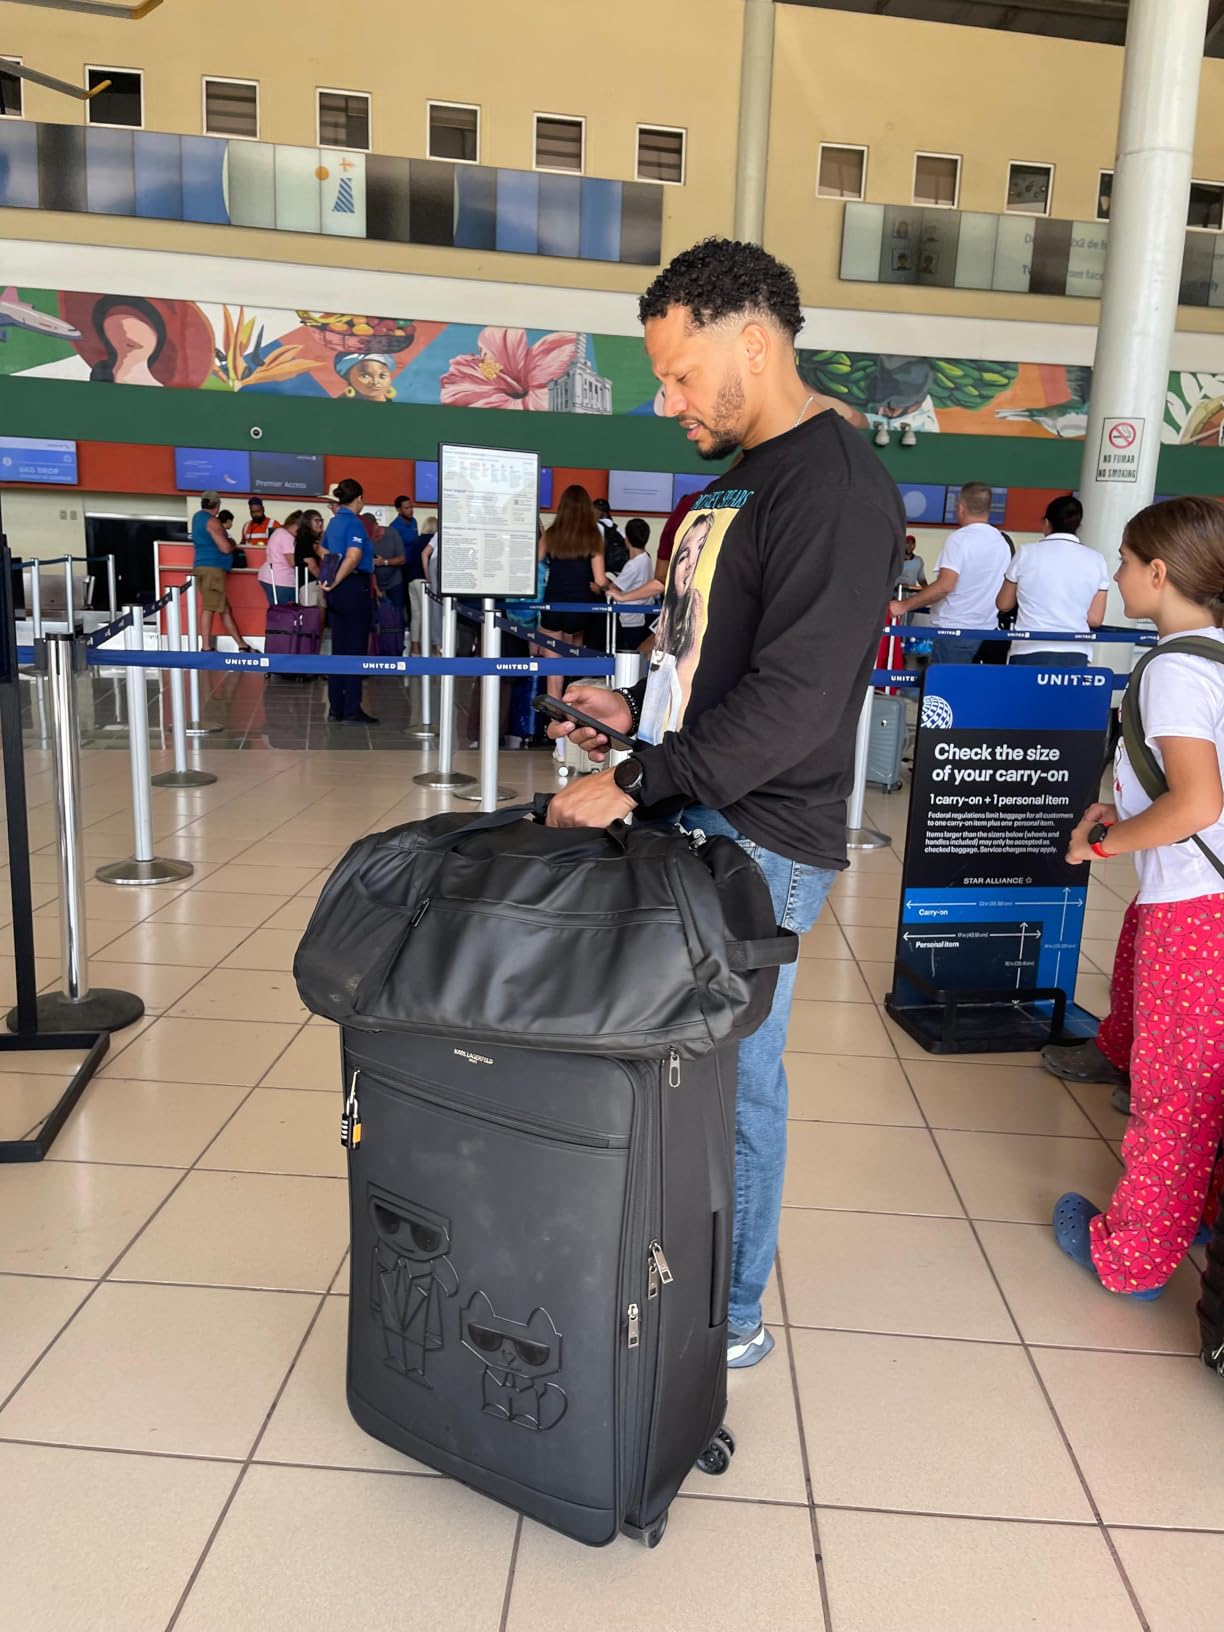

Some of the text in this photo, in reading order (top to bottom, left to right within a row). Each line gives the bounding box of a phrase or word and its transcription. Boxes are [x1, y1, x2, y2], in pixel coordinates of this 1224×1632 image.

[1103, 454, 1135, 463] NO FUMAR
[1098, 469, 1136, 478] NO SMOKING
[225, 658, 259, 666] UNITED
[362, 662, 396, 670] UNITED
[496, 663, 529, 671] UNITED
[1037, 674, 1106, 686] UNITED
[934, 743, 1060, 761] Check the size
[932, 765, 1069, 785] of your carry-on
[930, 793, 935, 804] 1
[936, 796, 983, 807] carry-on
[993, 794, 998, 805] 1
[999, 795, 1045, 807] personal
[1046, 795, 1069, 806] item
[952, 812, 986, 820] regulations
[1000, 812, 1026, 820] baggage
[988, 820, 1000, 828] plus
[1014, 820, 1040, 828] personal
[944, 831, 962, 840] larger
[950, 839, 979, 847] included)
[993, 839, 1005, 847] only
[951, 847, 979, 855] baggage.
[1003, 847, 1026, 855] charges
[963, 877, 1024, 885] STAR ALLIANCE
[919, 909, 949, 917] Carry-on
[916, 941, 944, 949] Personal
